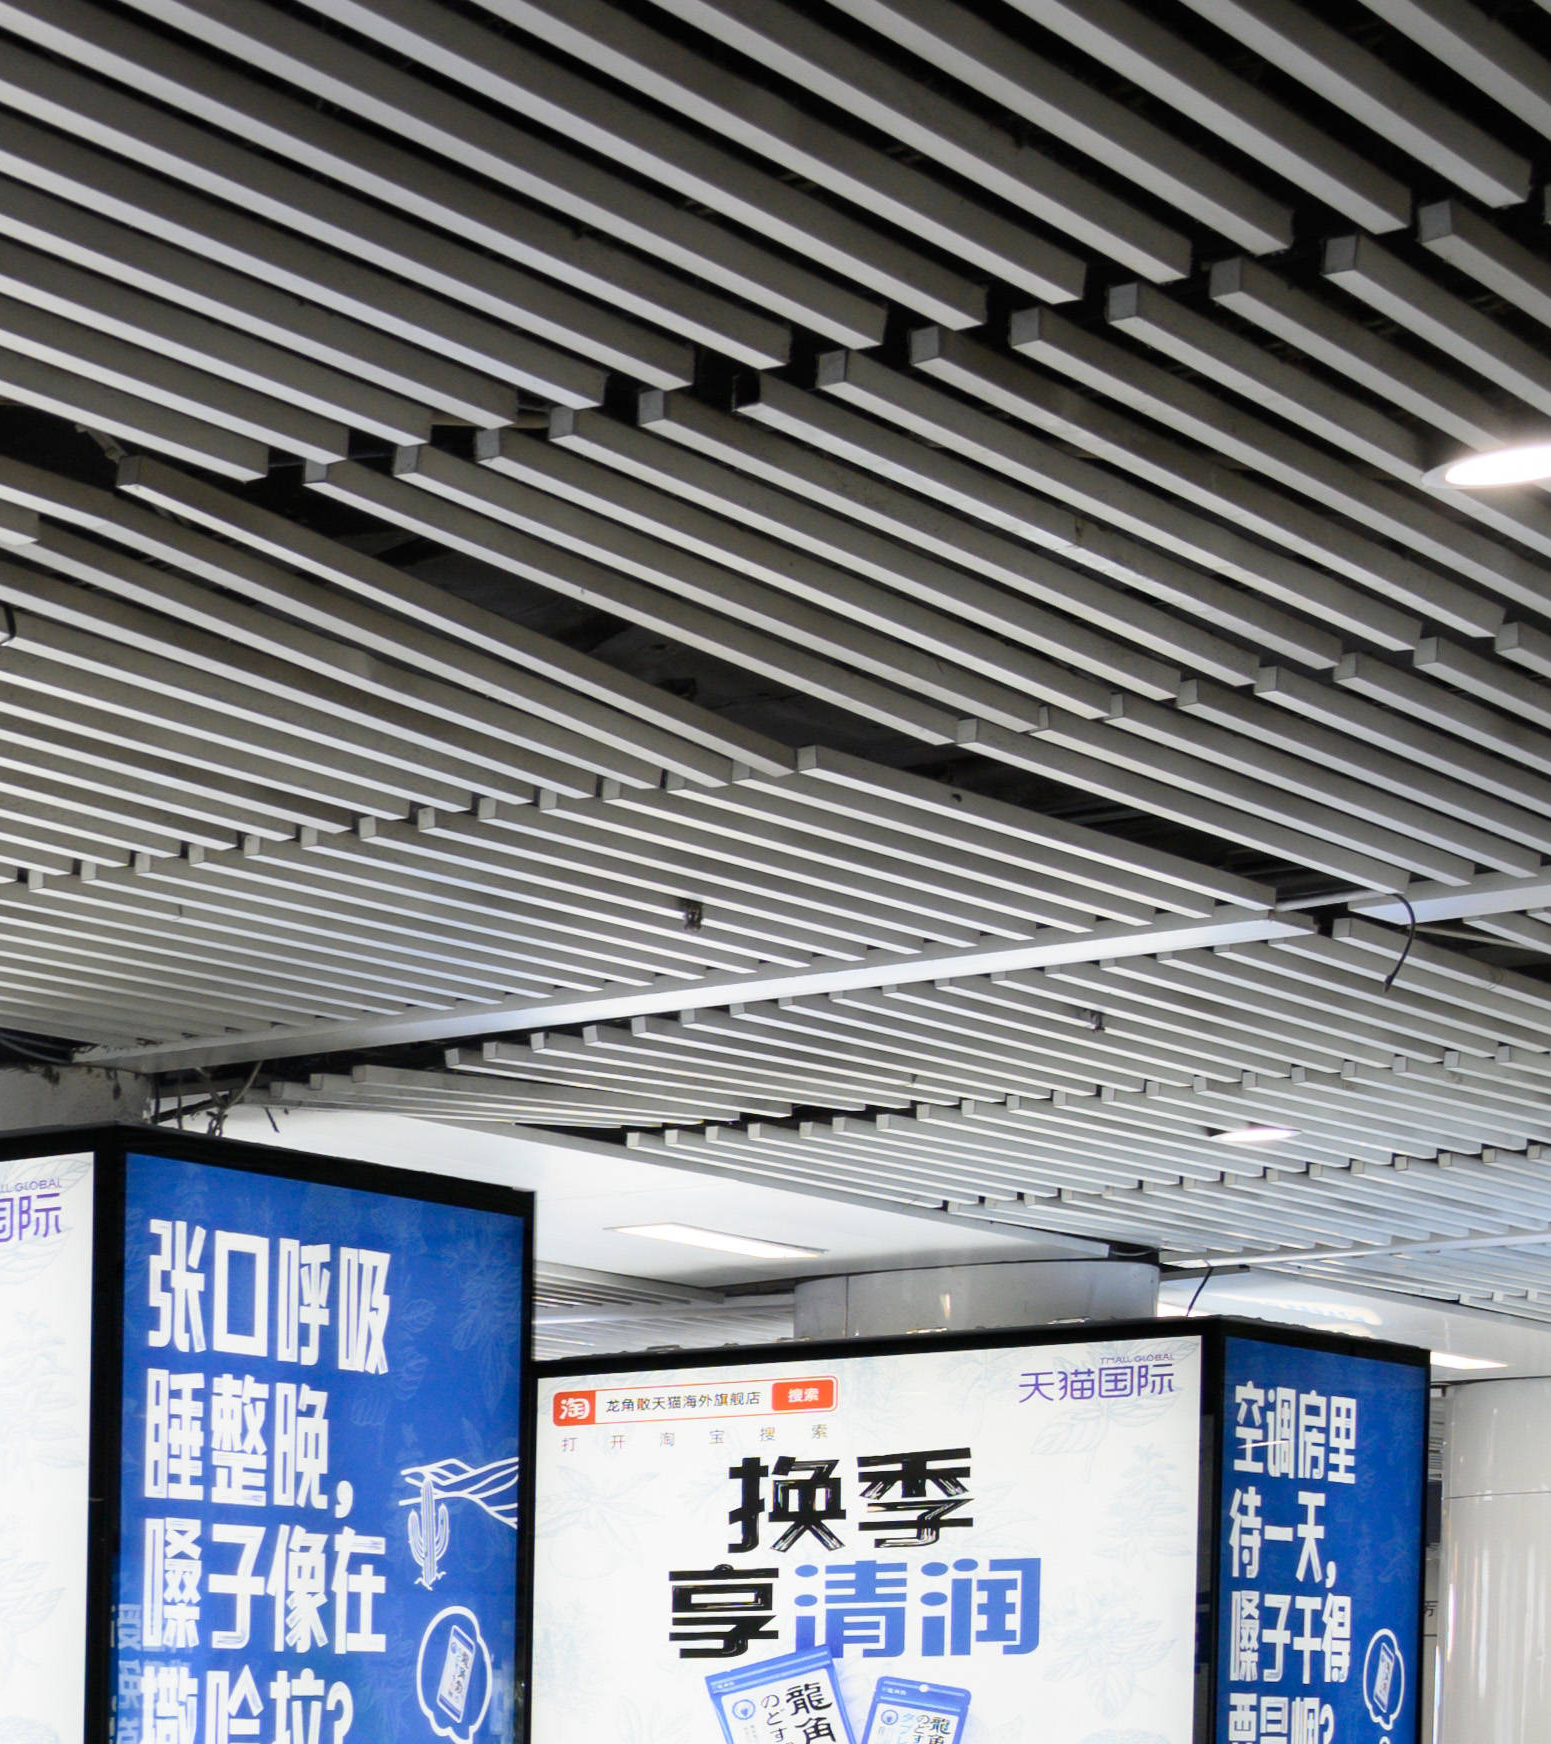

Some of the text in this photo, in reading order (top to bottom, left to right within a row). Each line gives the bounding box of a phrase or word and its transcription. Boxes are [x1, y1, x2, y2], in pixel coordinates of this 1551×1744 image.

[14, 1177, 63, 1193] GLOBAL
[145, 1218, 392, 1375] 张口呼吸
[559, 1387, 820, 1420] 淘 龙角散天猫海外旗舰店 搜索
[1019, 1363, 1175, 1404] 天猫国际
[1233, 1380, 1357, 1485] 空调房里
[144, 1366, 354, 1516] 睡整晚，
[561, 1423, 829, 1453] 打开淘宝搜索
[727, 1447, 975, 1555] 换季
[142, 1515, 388, 1655] 嗓子像在
[668, 1557, 1042, 1660] 享清润
[1228, 1589, 1352, 1686] 嗓子干得
